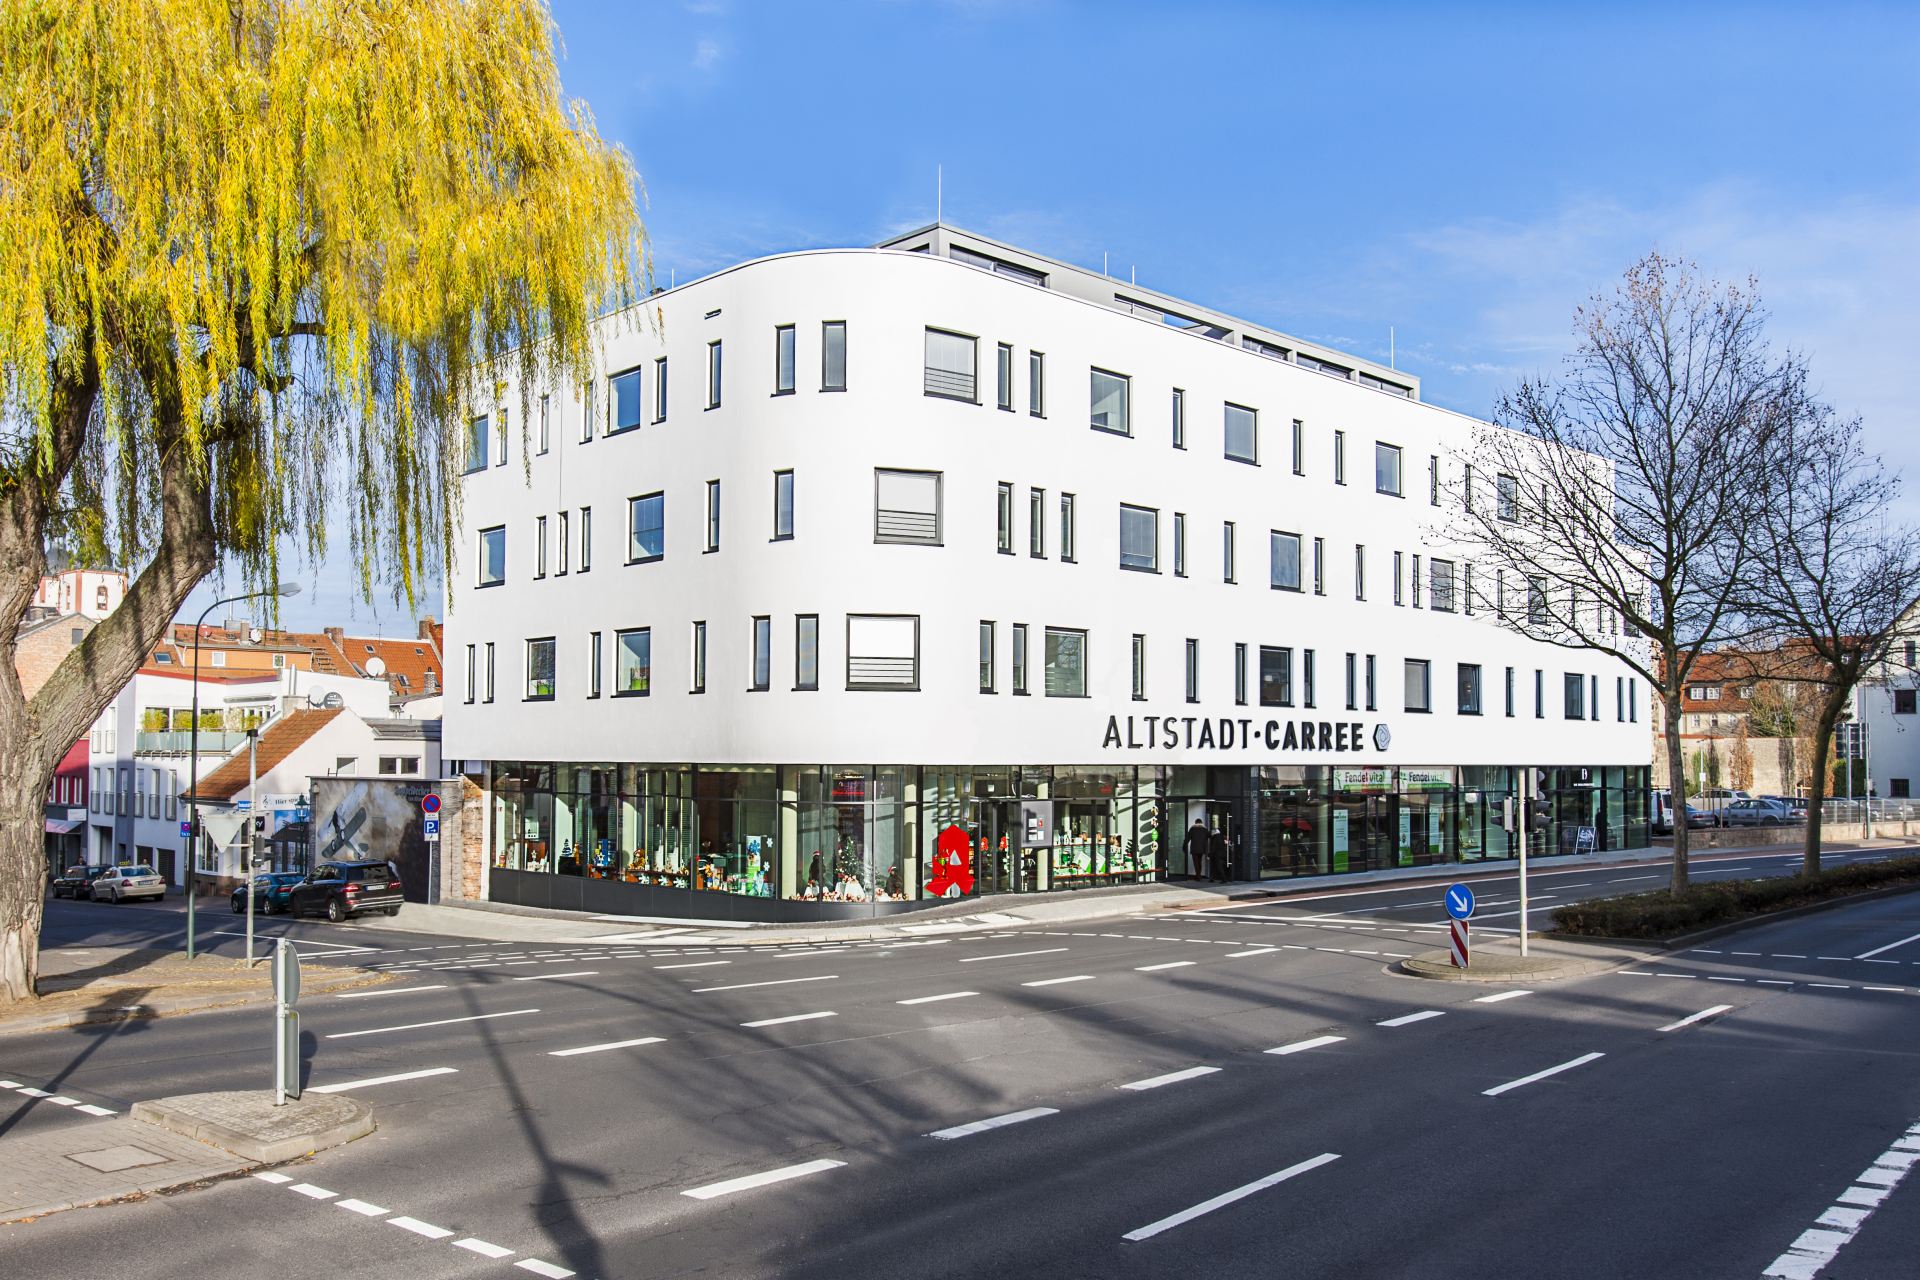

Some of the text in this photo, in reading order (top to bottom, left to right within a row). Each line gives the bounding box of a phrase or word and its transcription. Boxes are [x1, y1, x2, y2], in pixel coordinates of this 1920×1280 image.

[1345, 772, 1385, 783] Fendel vital
[1409, 772, 1430, 782] Fendel
[426, 822, 435, 833] P
